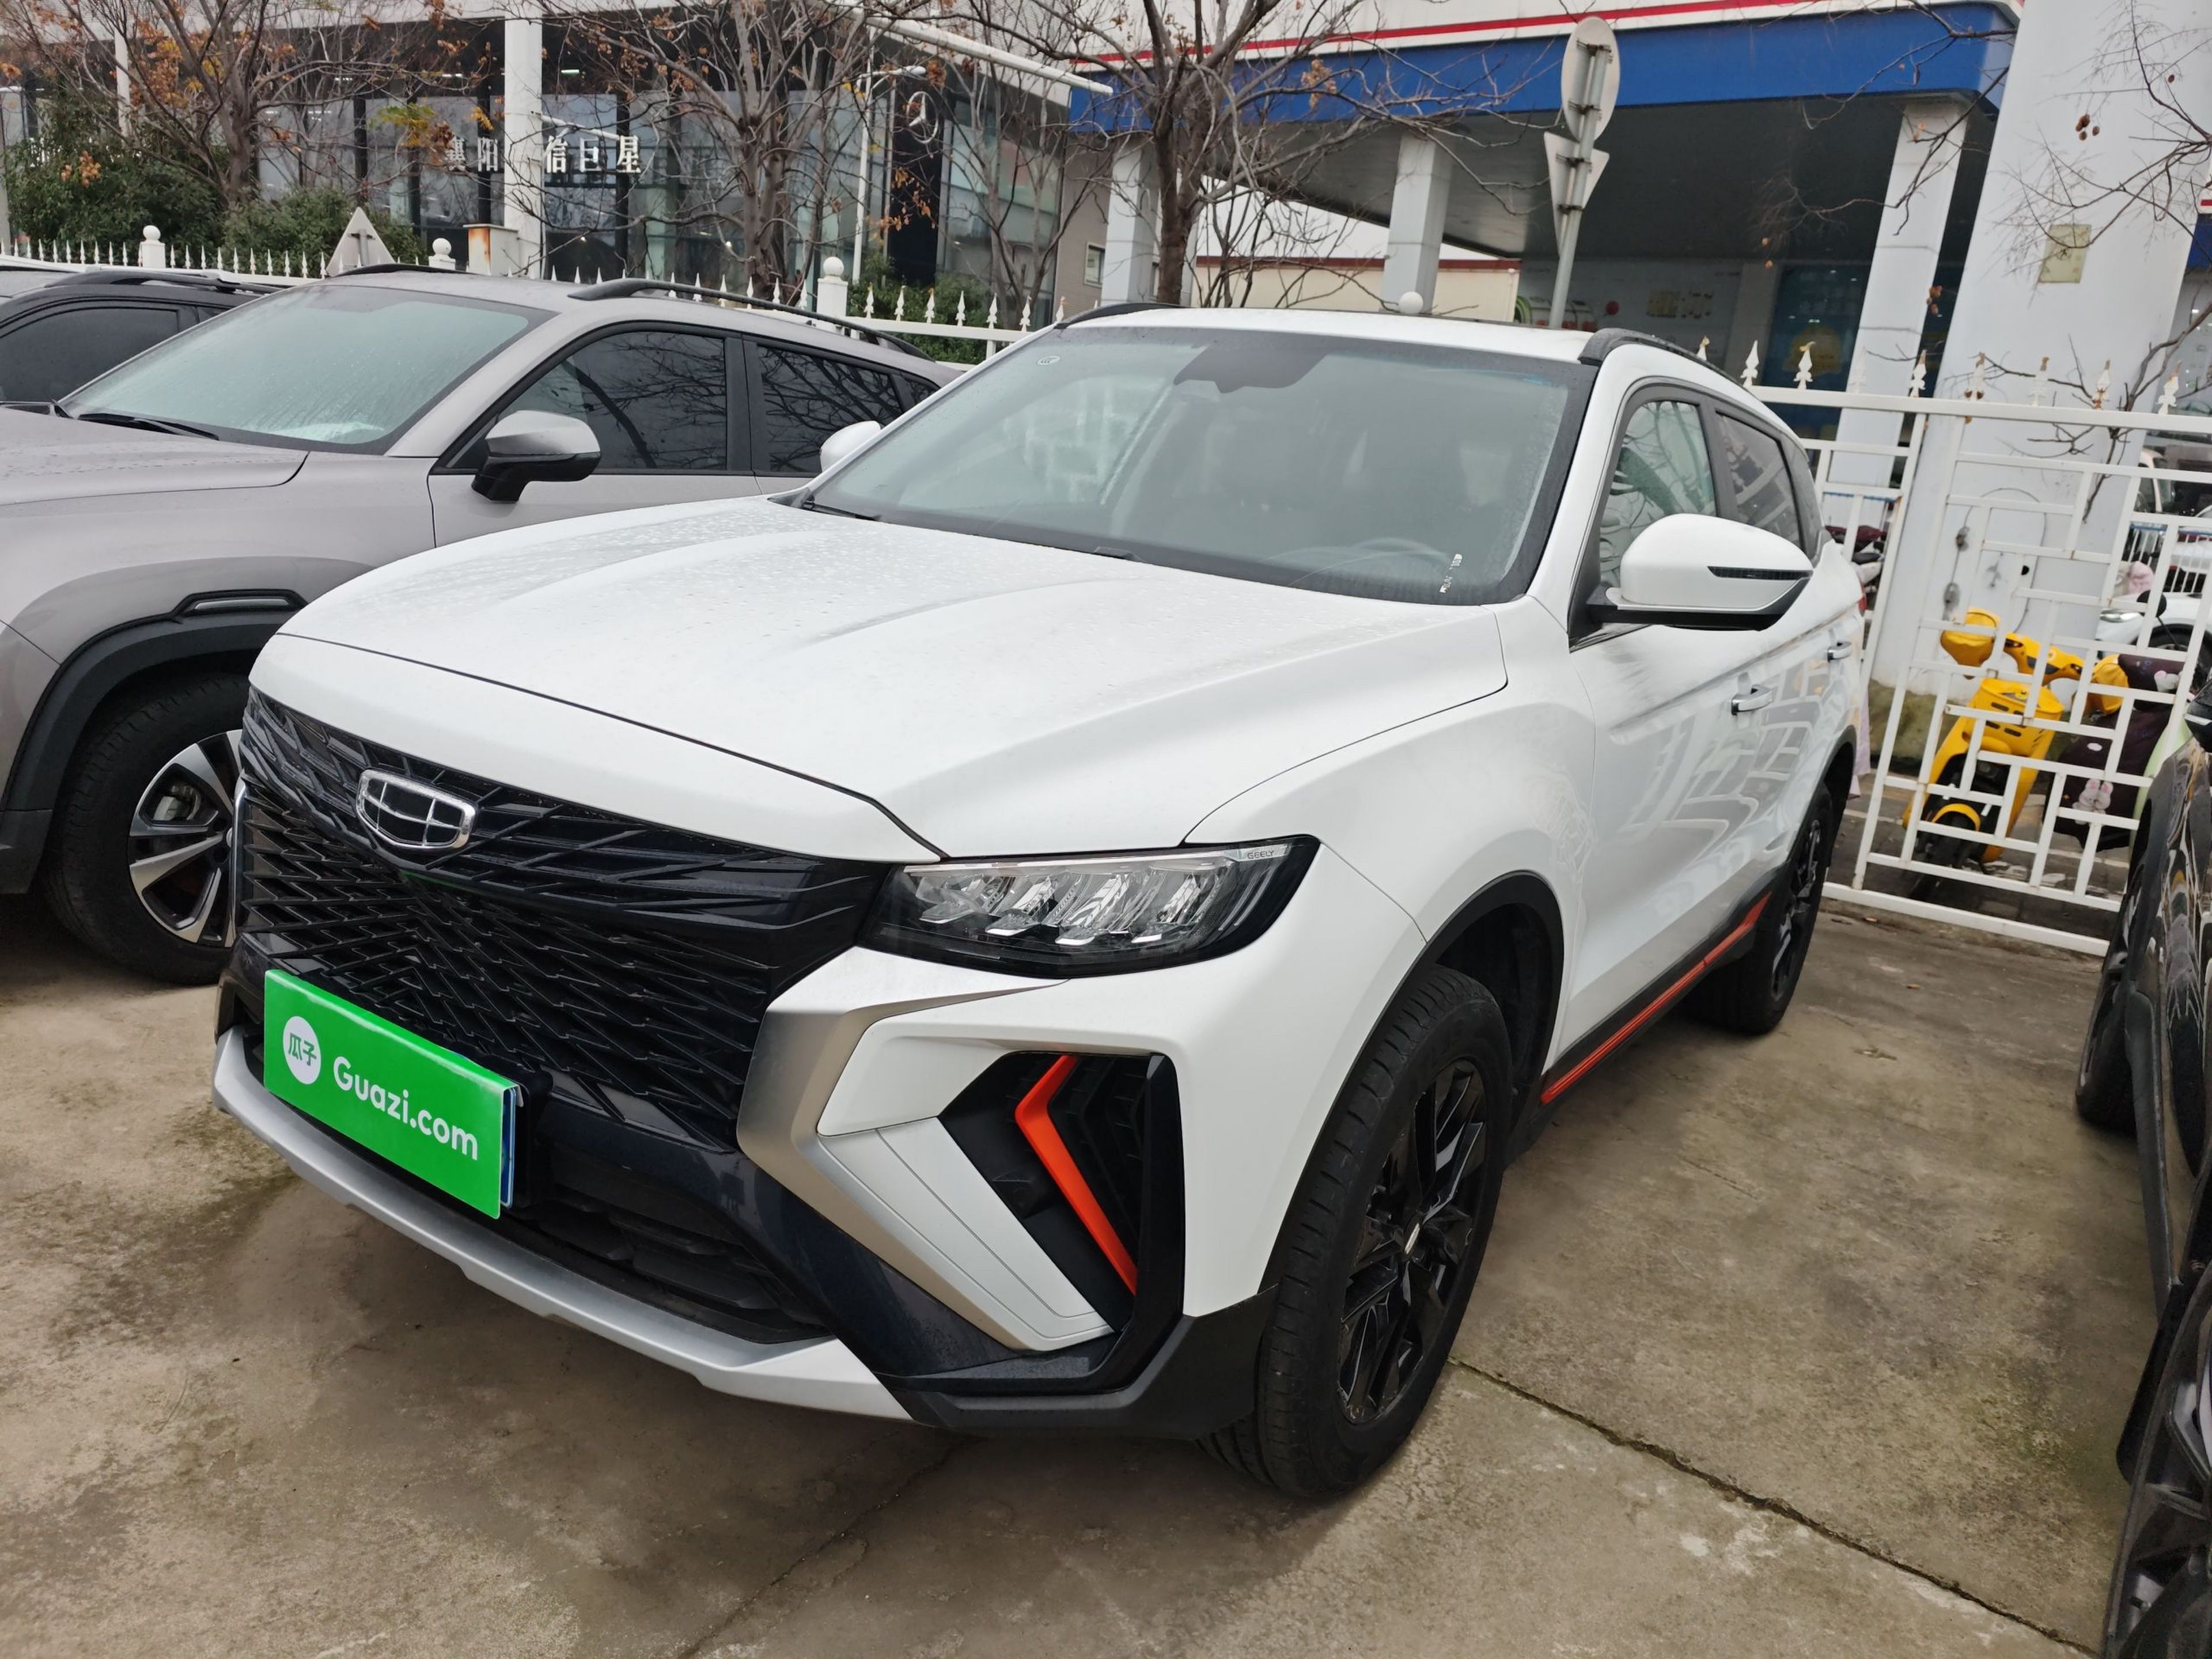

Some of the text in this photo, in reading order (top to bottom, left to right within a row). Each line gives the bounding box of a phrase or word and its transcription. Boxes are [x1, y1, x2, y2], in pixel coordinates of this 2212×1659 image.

[445, 134, 641, 173] 襄阳信巨星
[1247, 850, 1274, 859] GEELY
[288, 1032, 317, 1066] 瓜子
[333, 1056, 478, 1161] Guazi.com
